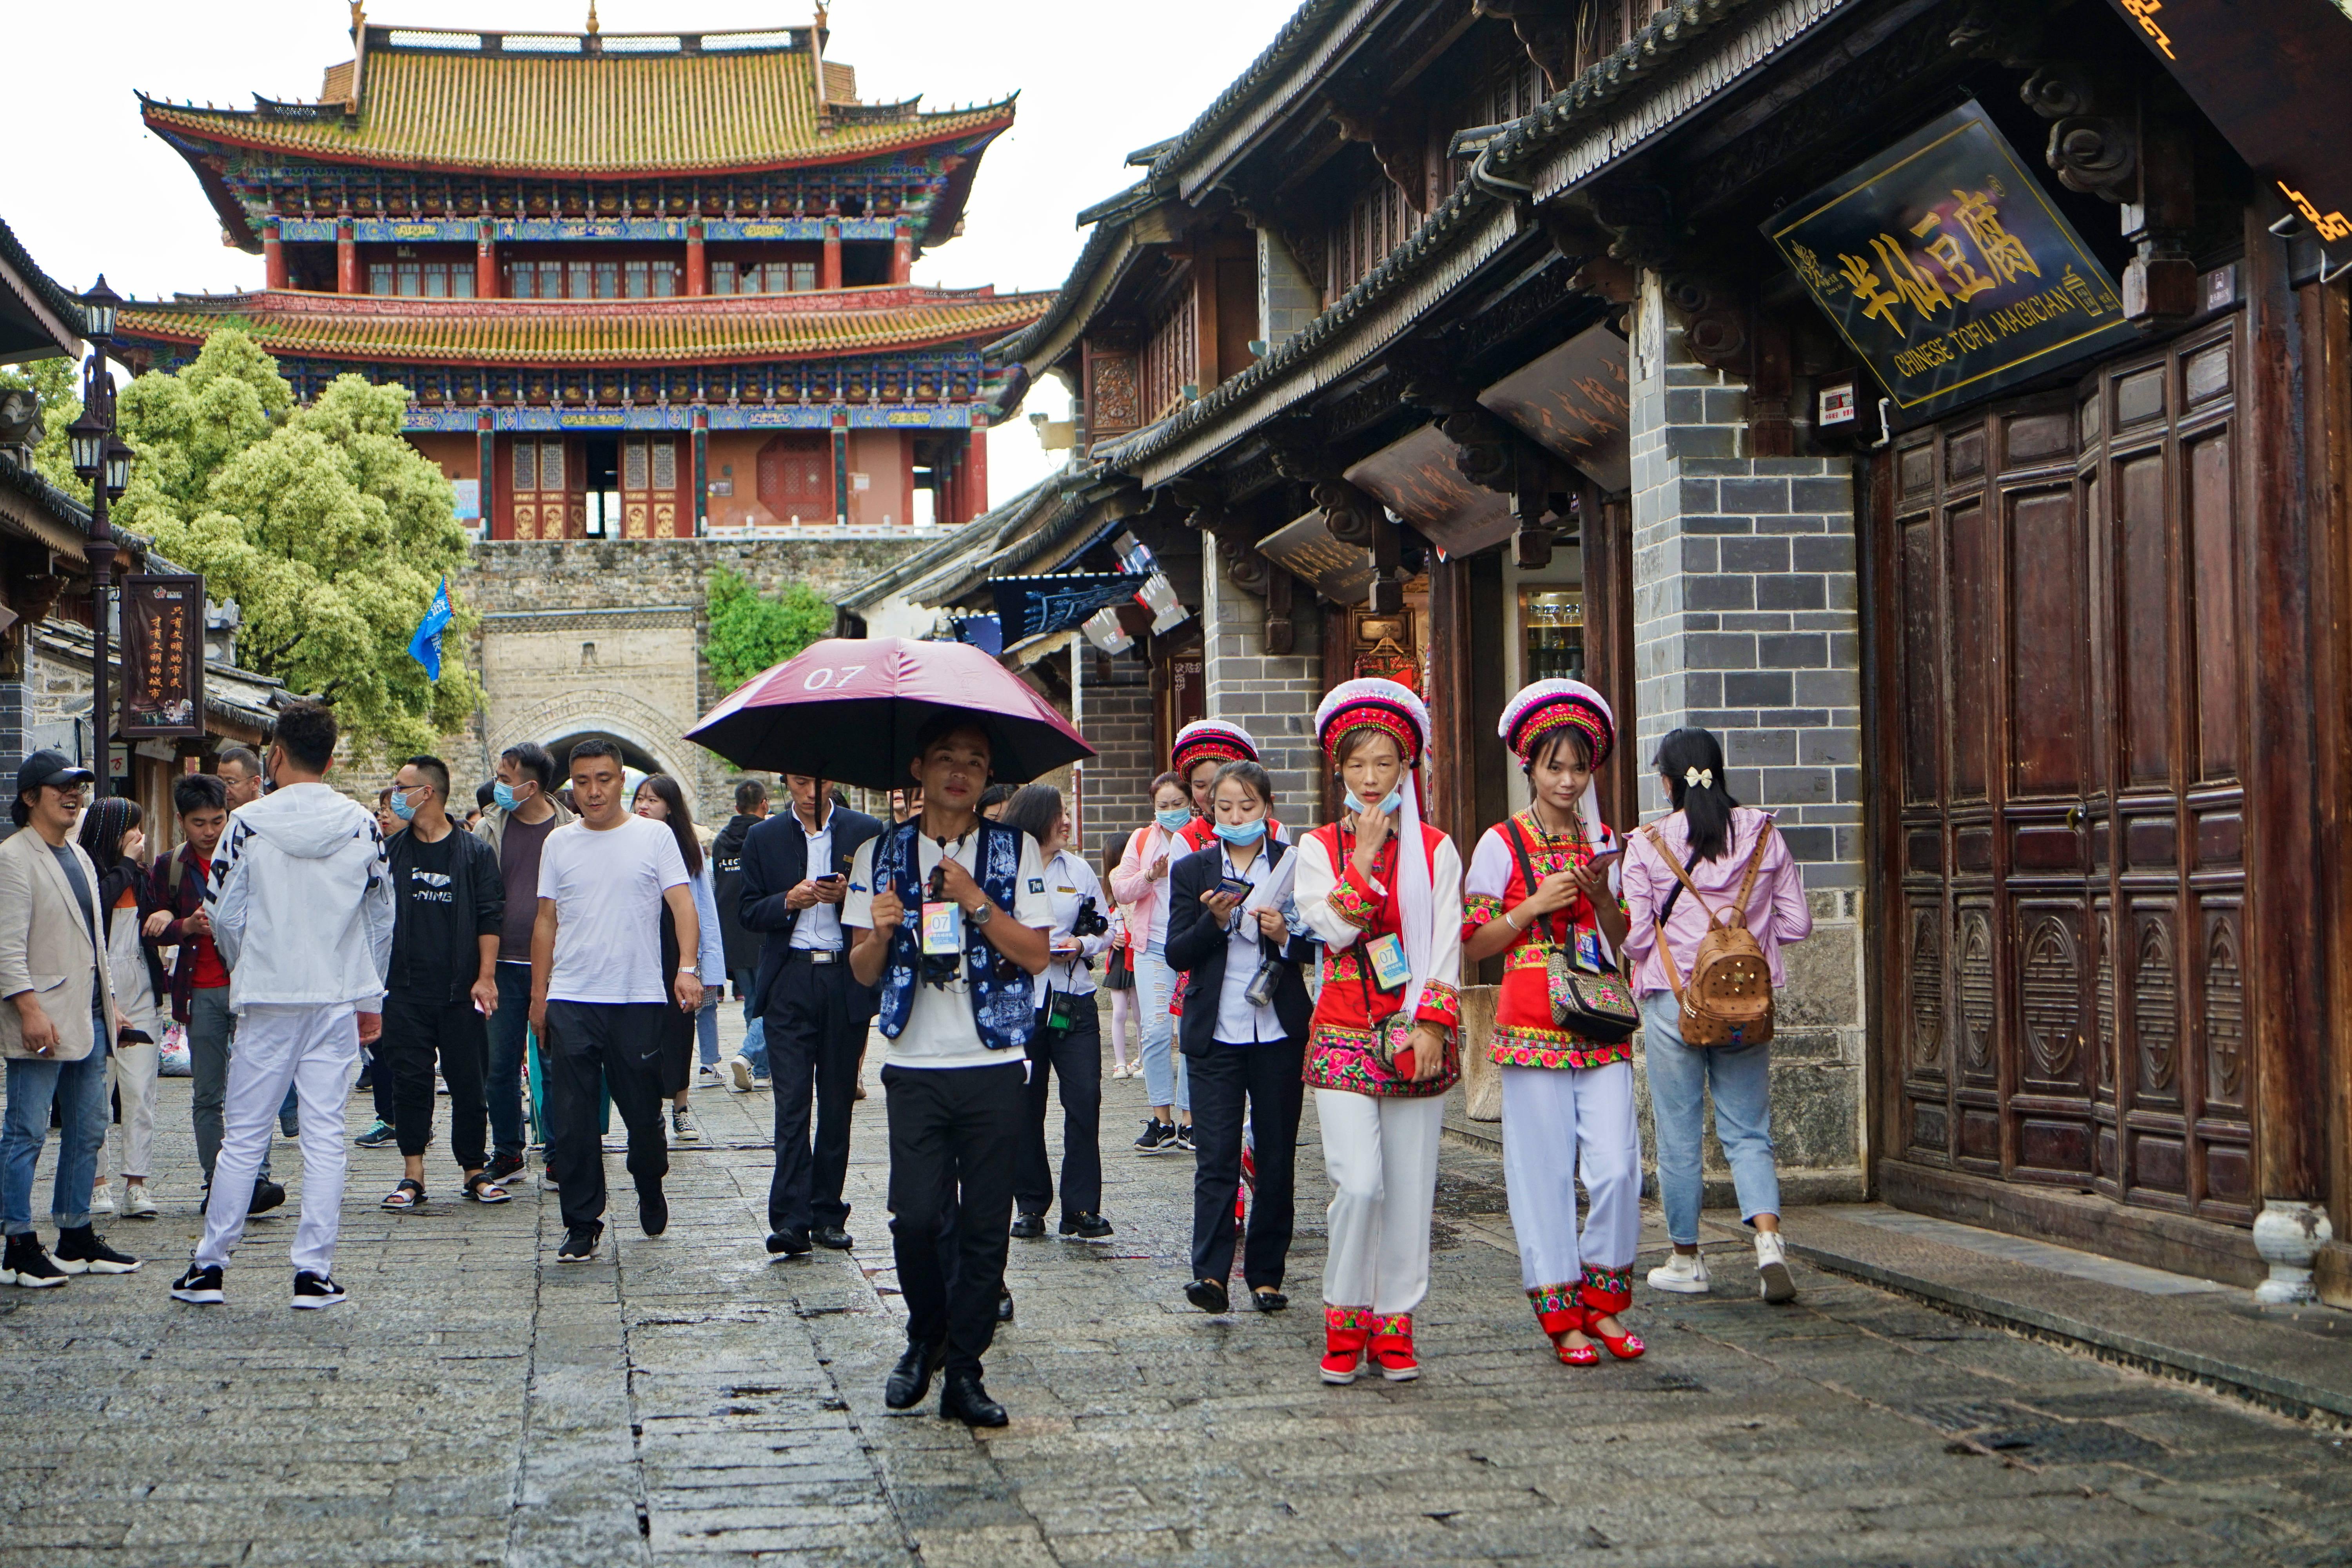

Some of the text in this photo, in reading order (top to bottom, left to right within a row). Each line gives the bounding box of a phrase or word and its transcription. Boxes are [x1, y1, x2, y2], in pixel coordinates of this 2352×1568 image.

[1838, 190, 2040, 338] 半仙豆腐
[1894, 285, 2075, 377] CHINESE TOFU MAGICIAN
[148, 616, 163, 700] 才有文明的城市
[170, 606, 183, 689] 只有文明的市民
[804, 665, 867, 691] 07
[1030, 880, 1042, 892] 7up
[933, 916, 949, 929] 07
[1379, 949, 1394, 964] 07
